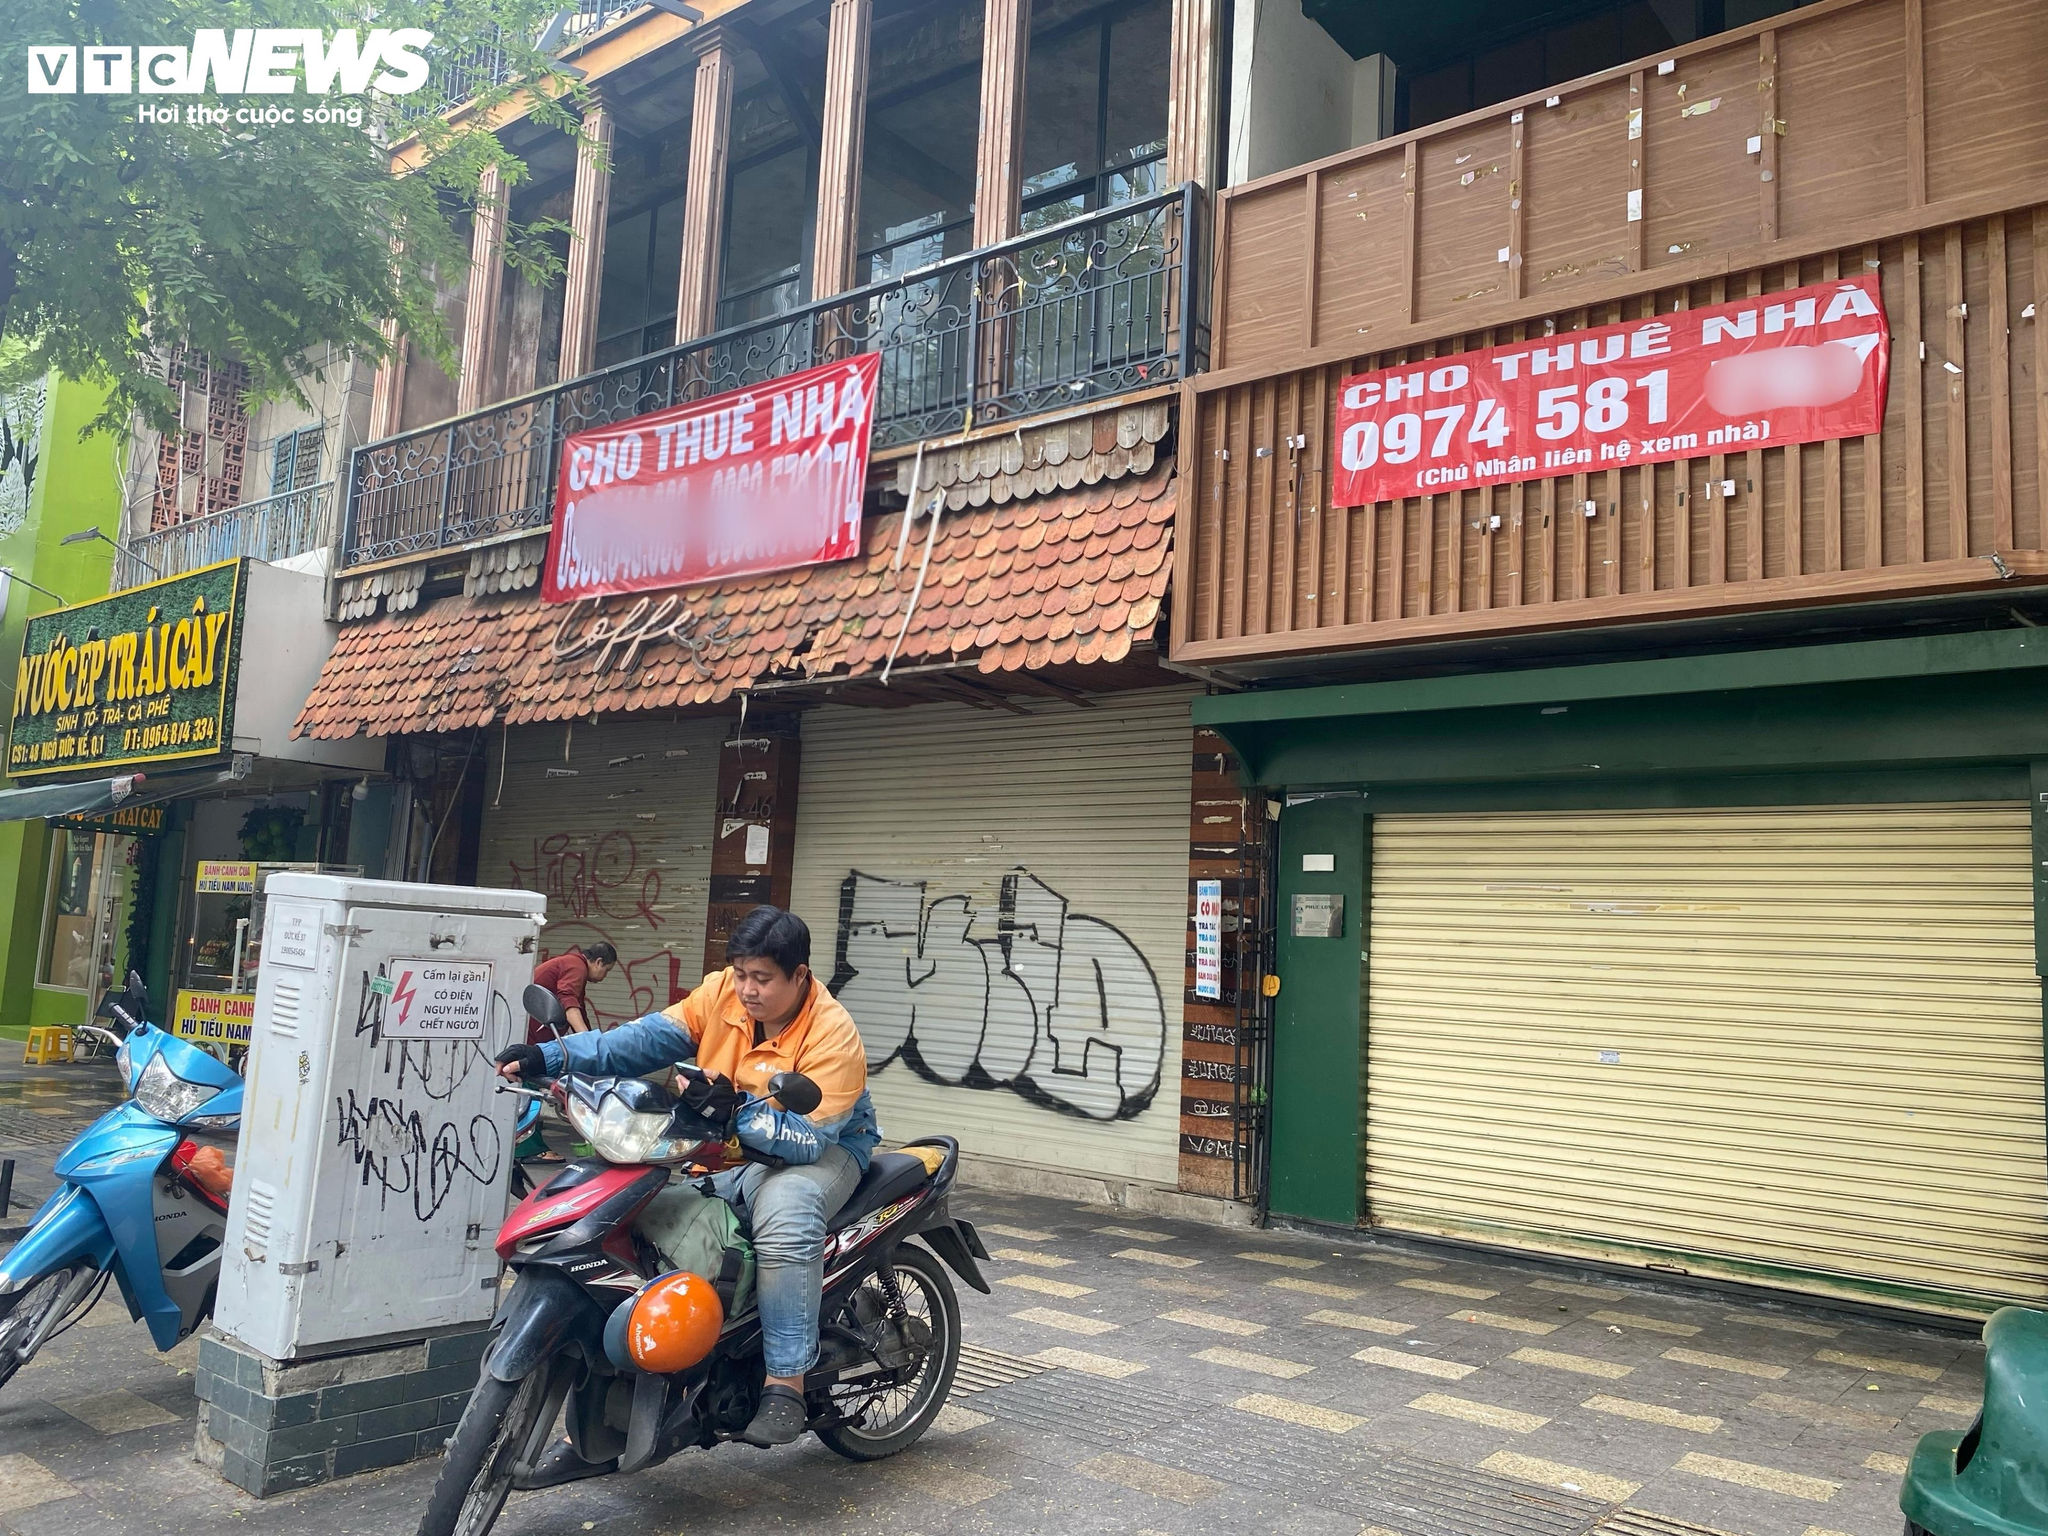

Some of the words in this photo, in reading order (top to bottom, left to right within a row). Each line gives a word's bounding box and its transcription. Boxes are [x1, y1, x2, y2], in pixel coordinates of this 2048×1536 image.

[1344, 365, 1469, 409] CHO
[1492, 322, 1672, 381] THUÊ
[1702, 284, 1879, 345] NHÀ
[569, 433, 642, 491] CHO
[655, 392, 757, 472] THUÊ
[770, 364, 866, 447] NHÀ
[1342, 398, 1510, 471] 0974
[1535, 369, 1669, 441] 581
[1476, 453, 1536, 478] Nhân
[1545, 446, 1592, 468] liên
[1600, 438, 1631, 460] hệ
[1640, 431, 1697, 454] xem
[1707, 419, 1770, 446] nhà)
[107, 606, 171, 701] TRÁI
[169, 596, 226, 690] CÂY
[56, 714, 78, 732] SINH
[128, 701, 142, 721] CÀ
[147, 693, 170, 717] PHÊ
[29, 743, 39, 763] 48
[222, 880, 235, 892] NAM
[423, 968, 446, 981] Cấm
[448, 970, 460, 984] lại
[463, 969, 486, 984] gần!
[191, 993, 221, 1014] BÁNH
[224, 1000, 254, 1017] CANH
[434, 989, 447, 1000] CÓ
[450, 990, 473, 1002] ĐIỆN
[424, 1005, 451, 1015] NGUY
[454, 1002, 479, 1015] HIỂM
[181, 1014, 196, 1035] HỦ
[200, 1016, 222, 1038] TIẾU
[226, 1023, 252, 1041] NAM
[420, 1017, 443, 1030] CHẾT
[446, 1019, 479, 1031] NGƯỜI
[570, 1259, 609, 1273] HONDA
